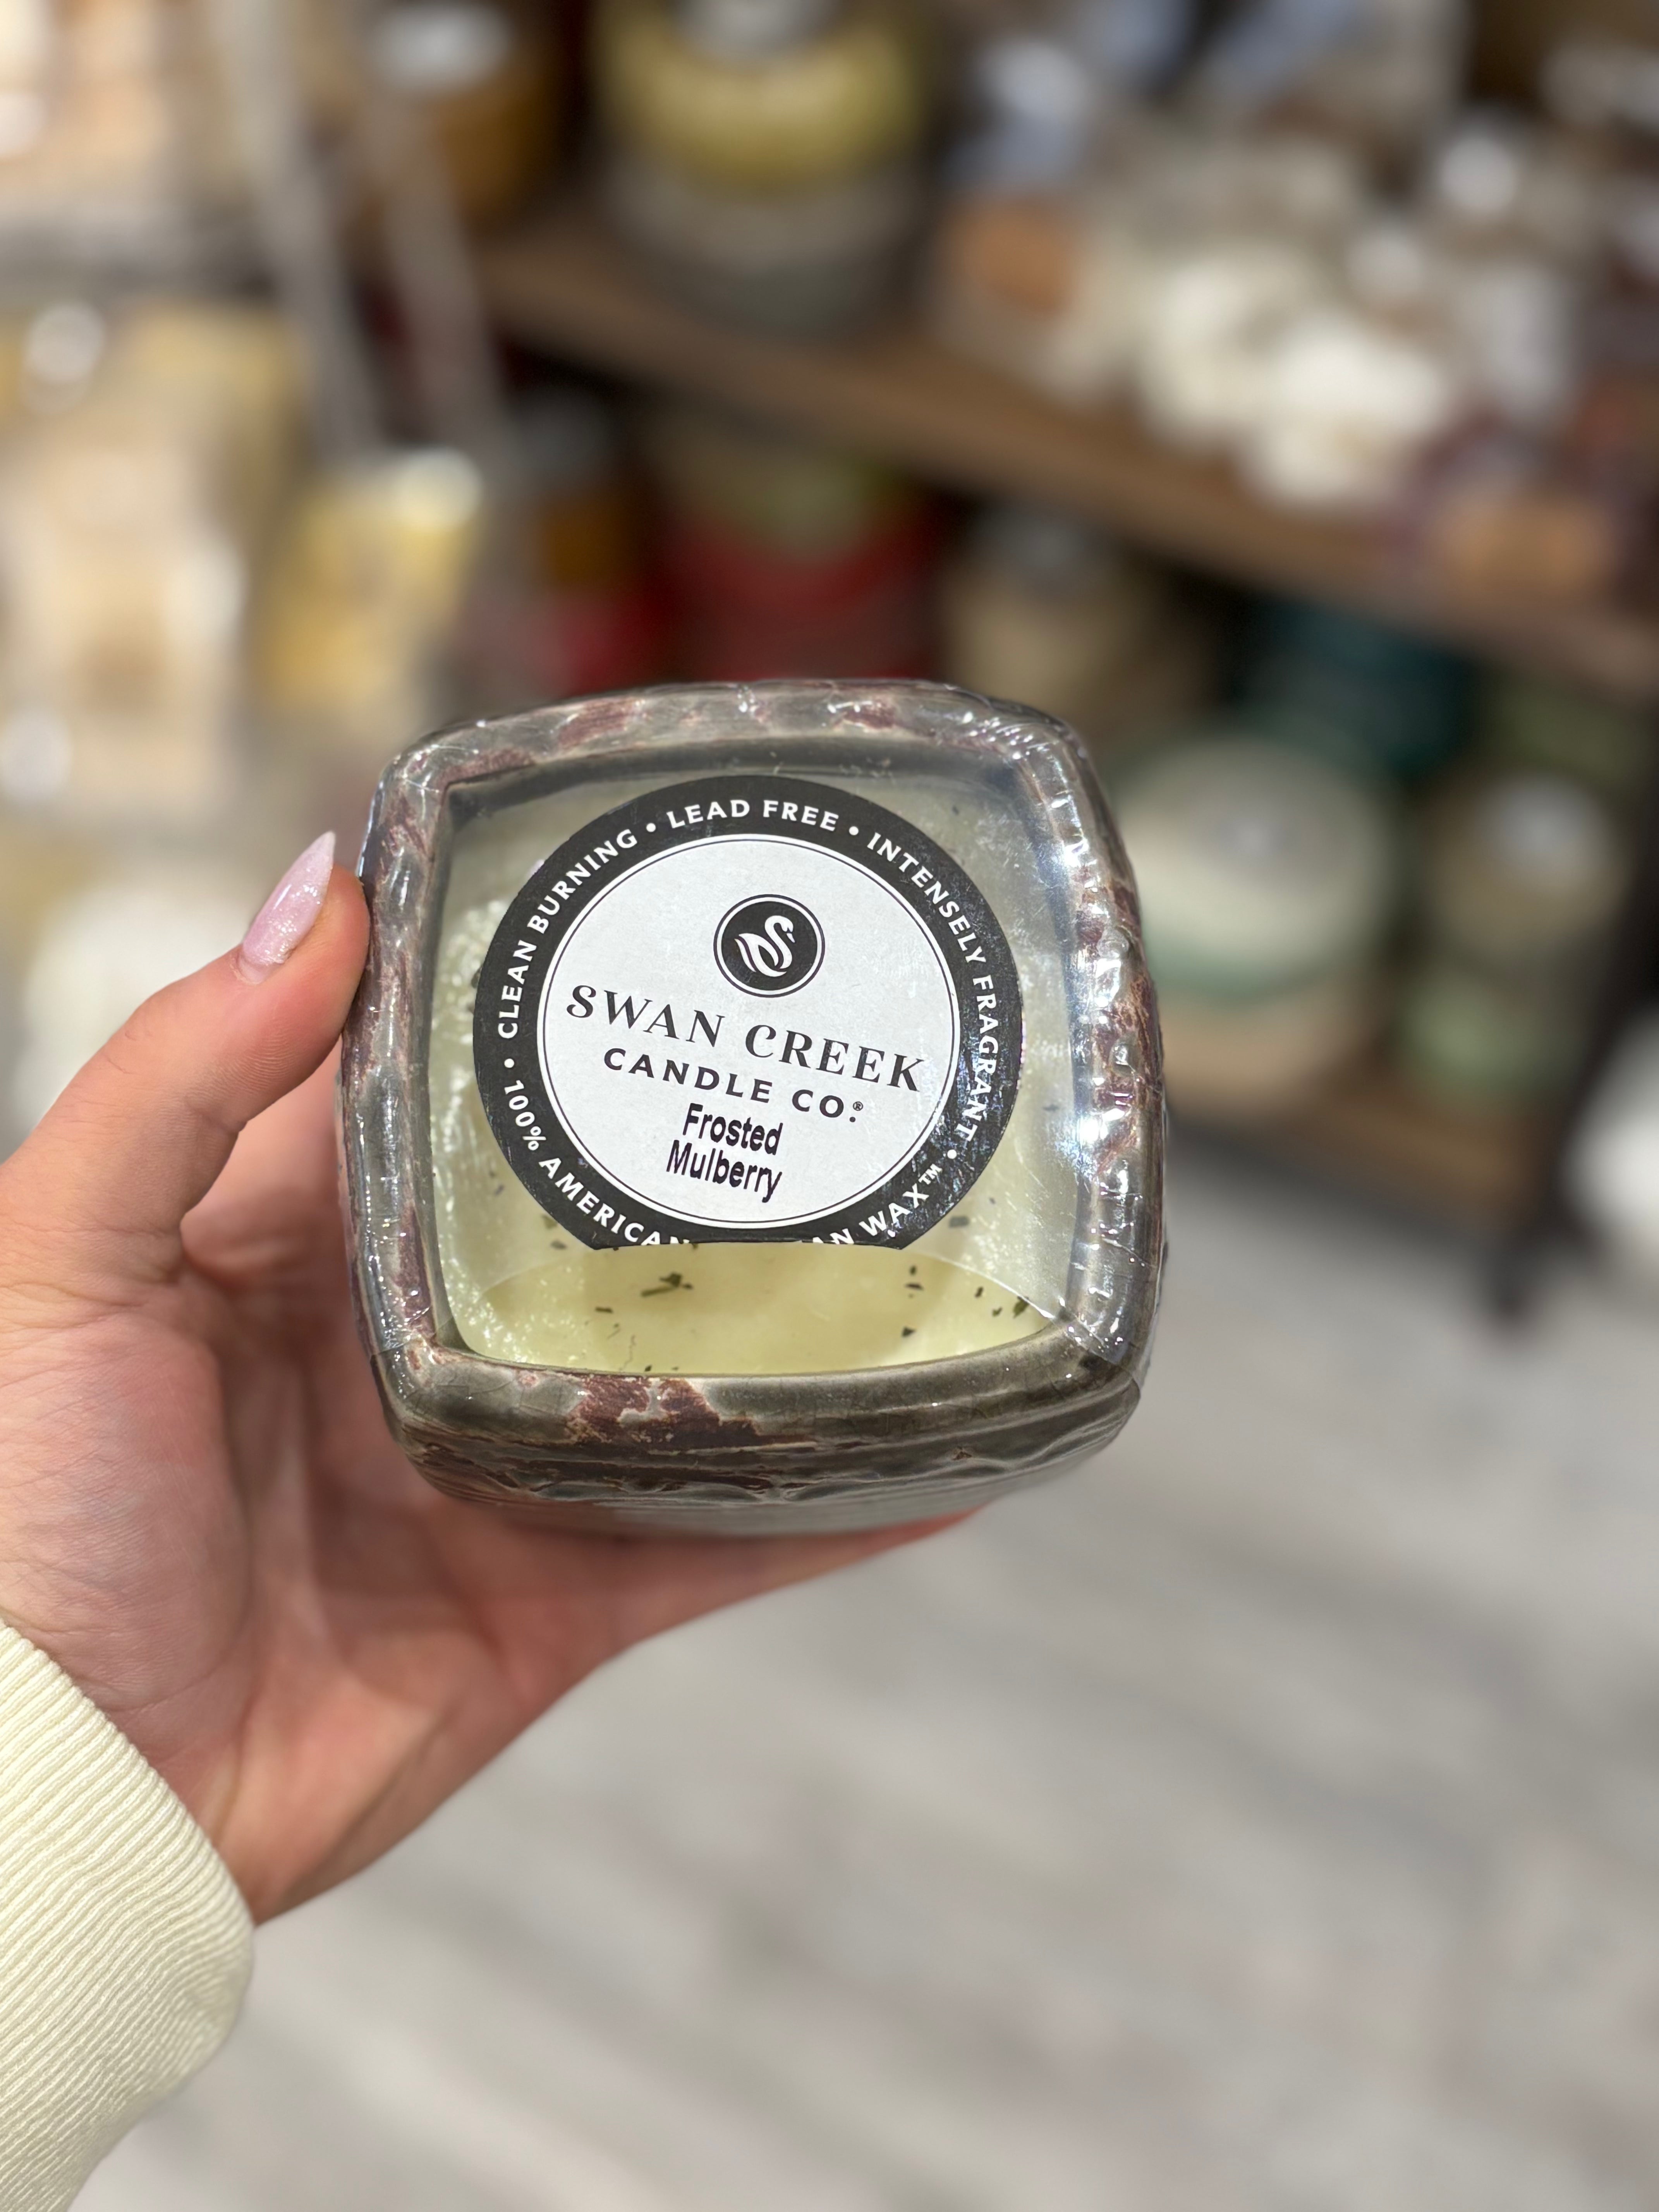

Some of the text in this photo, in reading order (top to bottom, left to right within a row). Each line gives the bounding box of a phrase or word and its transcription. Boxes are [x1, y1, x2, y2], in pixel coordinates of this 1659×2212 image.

[666, 800, 839, 831] LEAD FREE
[498, 829, 637, 1039] CLEAN BURNING
[867, 832, 999, 1141] INTENSELY FRAGRANT
[567, 985, 923, 1091] SWAN CREEK
[604, 1048, 772, 1103] CANDLE
[504, 1079, 546, 1151] 100%
[683, 1103, 783, 1156] Frosted
[666, 1140, 782, 1203] Mulberry
